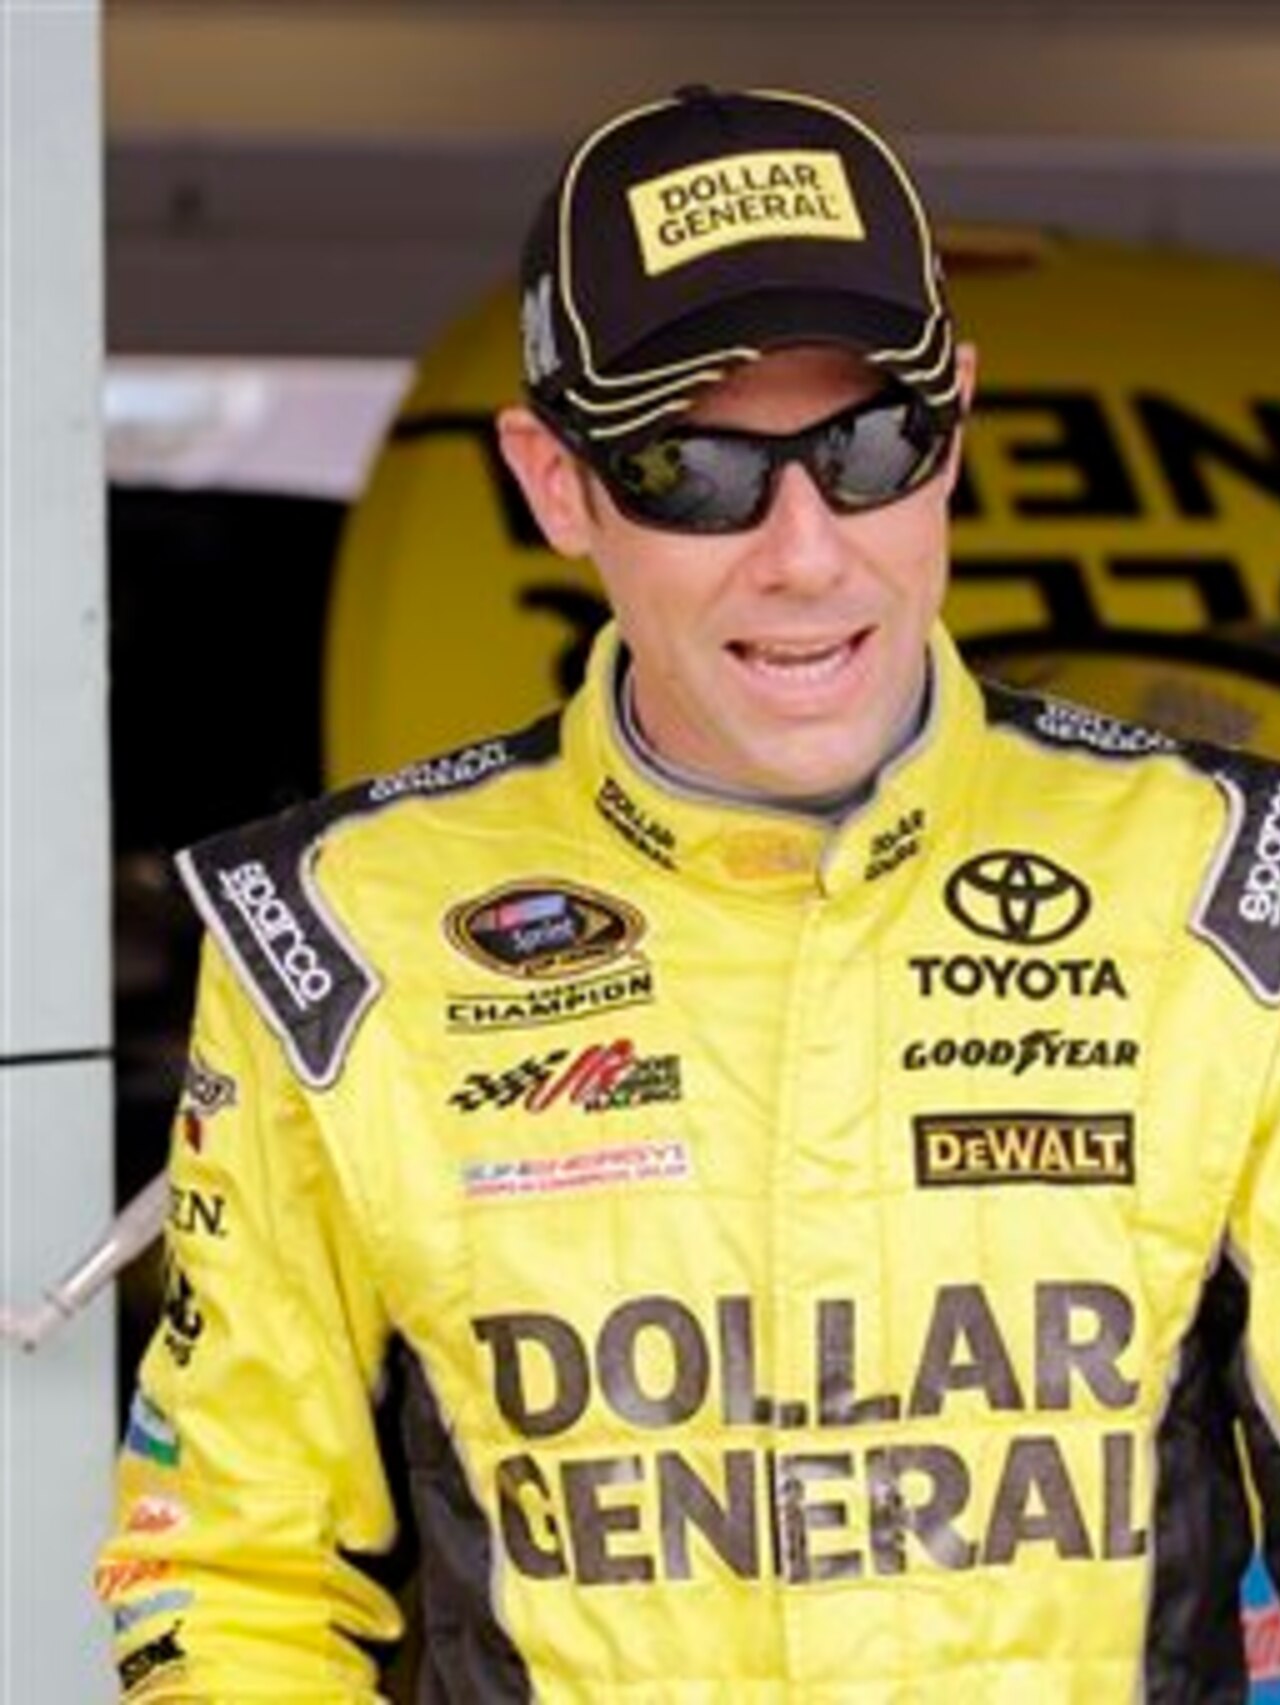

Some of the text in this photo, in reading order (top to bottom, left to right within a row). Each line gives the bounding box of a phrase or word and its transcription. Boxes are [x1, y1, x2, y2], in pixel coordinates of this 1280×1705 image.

[660, 163, 821, 214] DOLLAR
[658, 194, 842, 248] GENERAL
[222, 862, 332, 1004] sparco
[448, 971, 652, 1022] CHAMPION
[908, 955, 1128, 1001] TOYOTA
[903, 1034, 1140, 1073] GOODYEAR
[470, 1280, 1140, 1438] DOLLAR
[498, 1432, 1147, 1585] GENERAL
